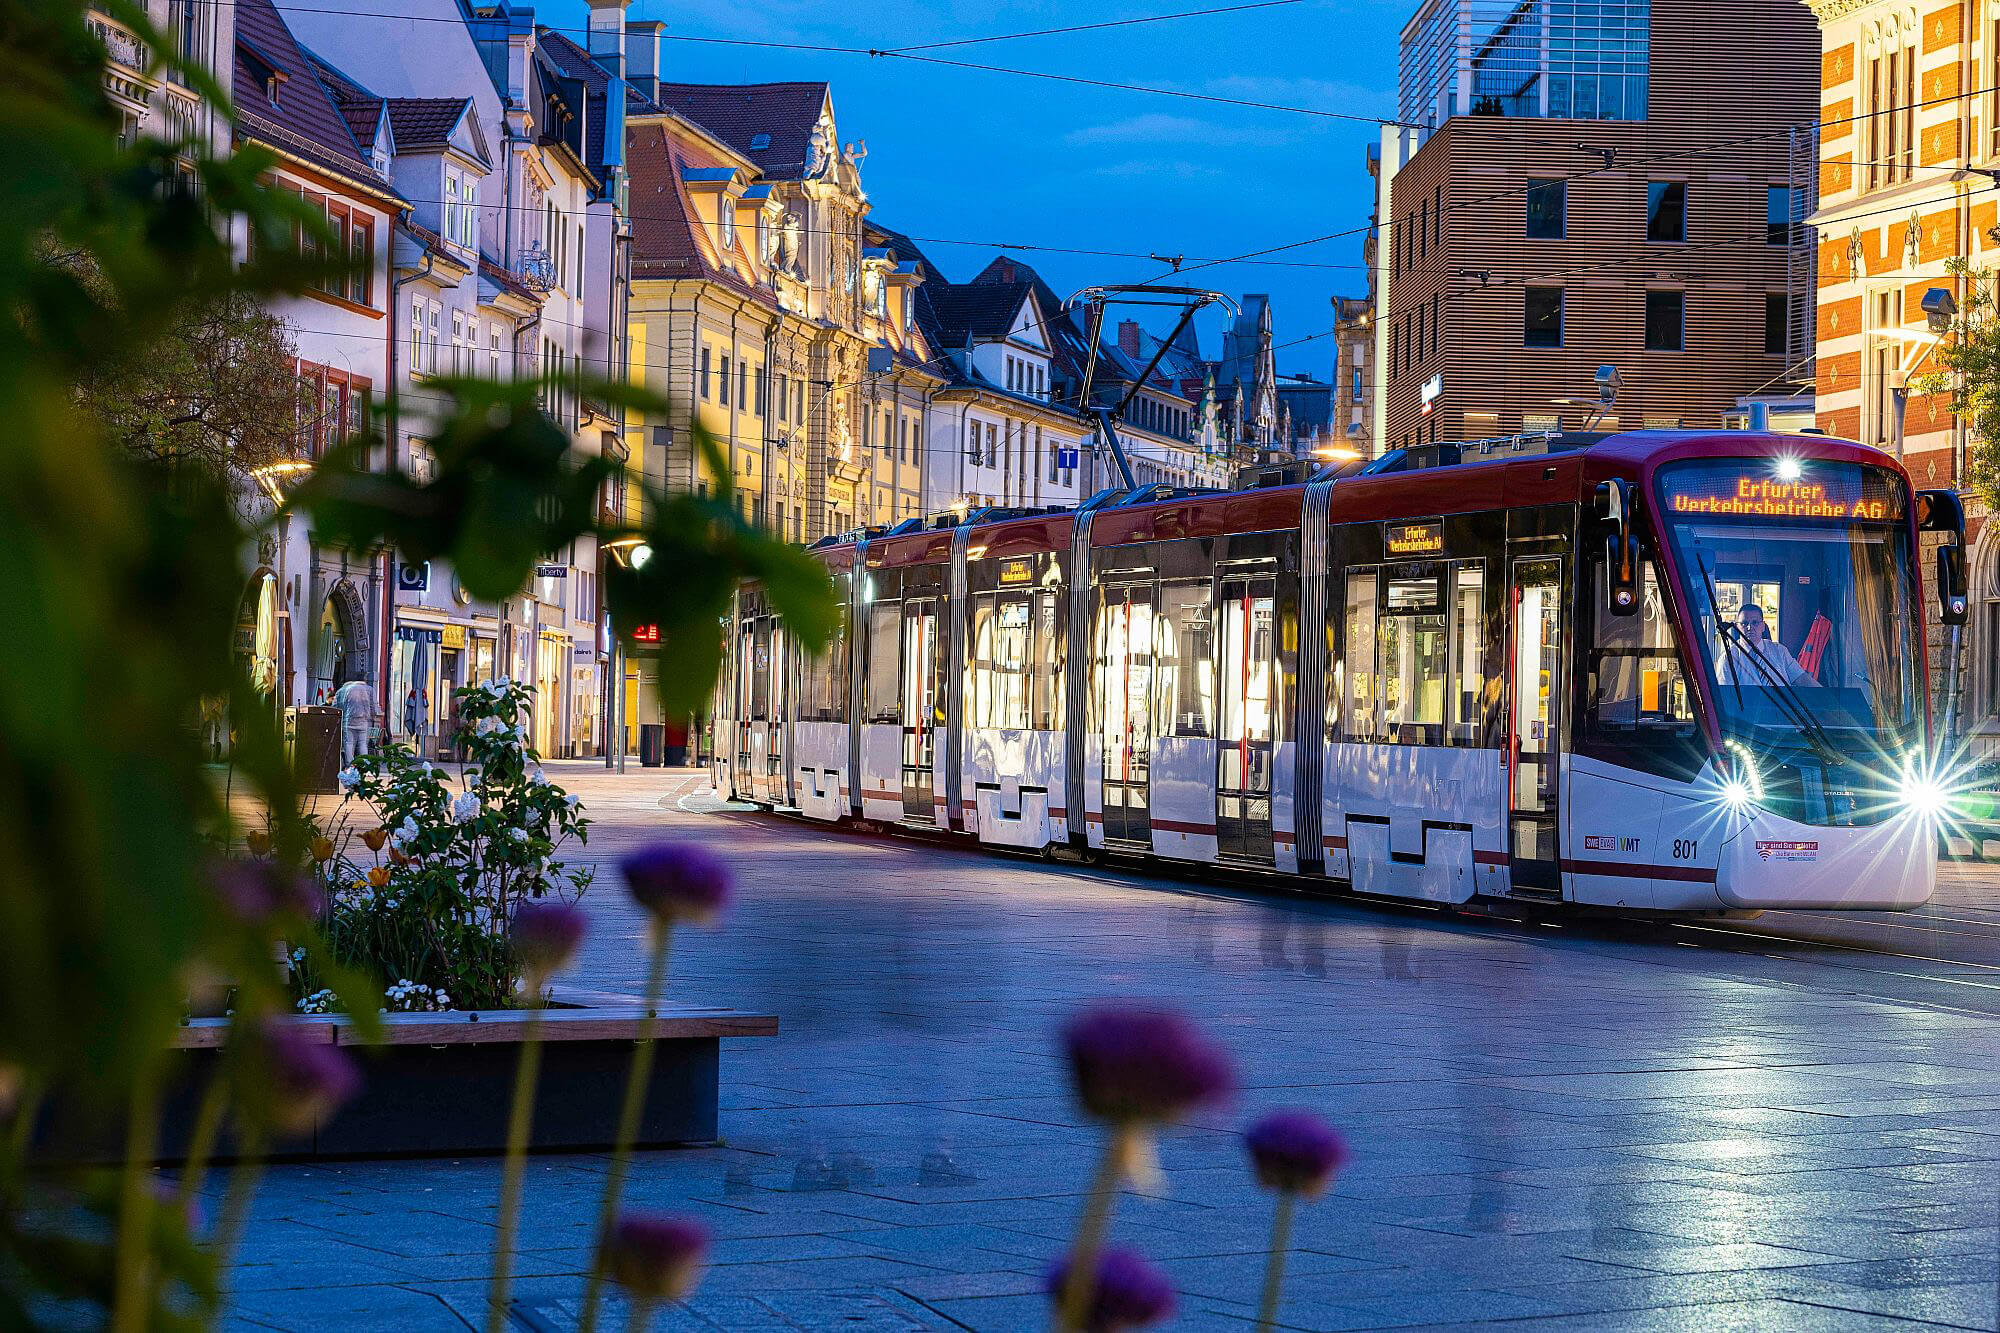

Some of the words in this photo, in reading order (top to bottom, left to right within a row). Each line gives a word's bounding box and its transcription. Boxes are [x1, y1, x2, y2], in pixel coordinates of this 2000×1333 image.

[1738, 479, 1822, 499] Erfurter
[1675, 495, 1844, 517] Verkehrsbetriebe
[1852, 502, 1883, 519] AG
[540, 567, 564, 577] liberty
[1586, 836, 1599, 848] SWE
[1619, 837, 1640, 852] VMT
[1672, 839, 1698, 860] 801
